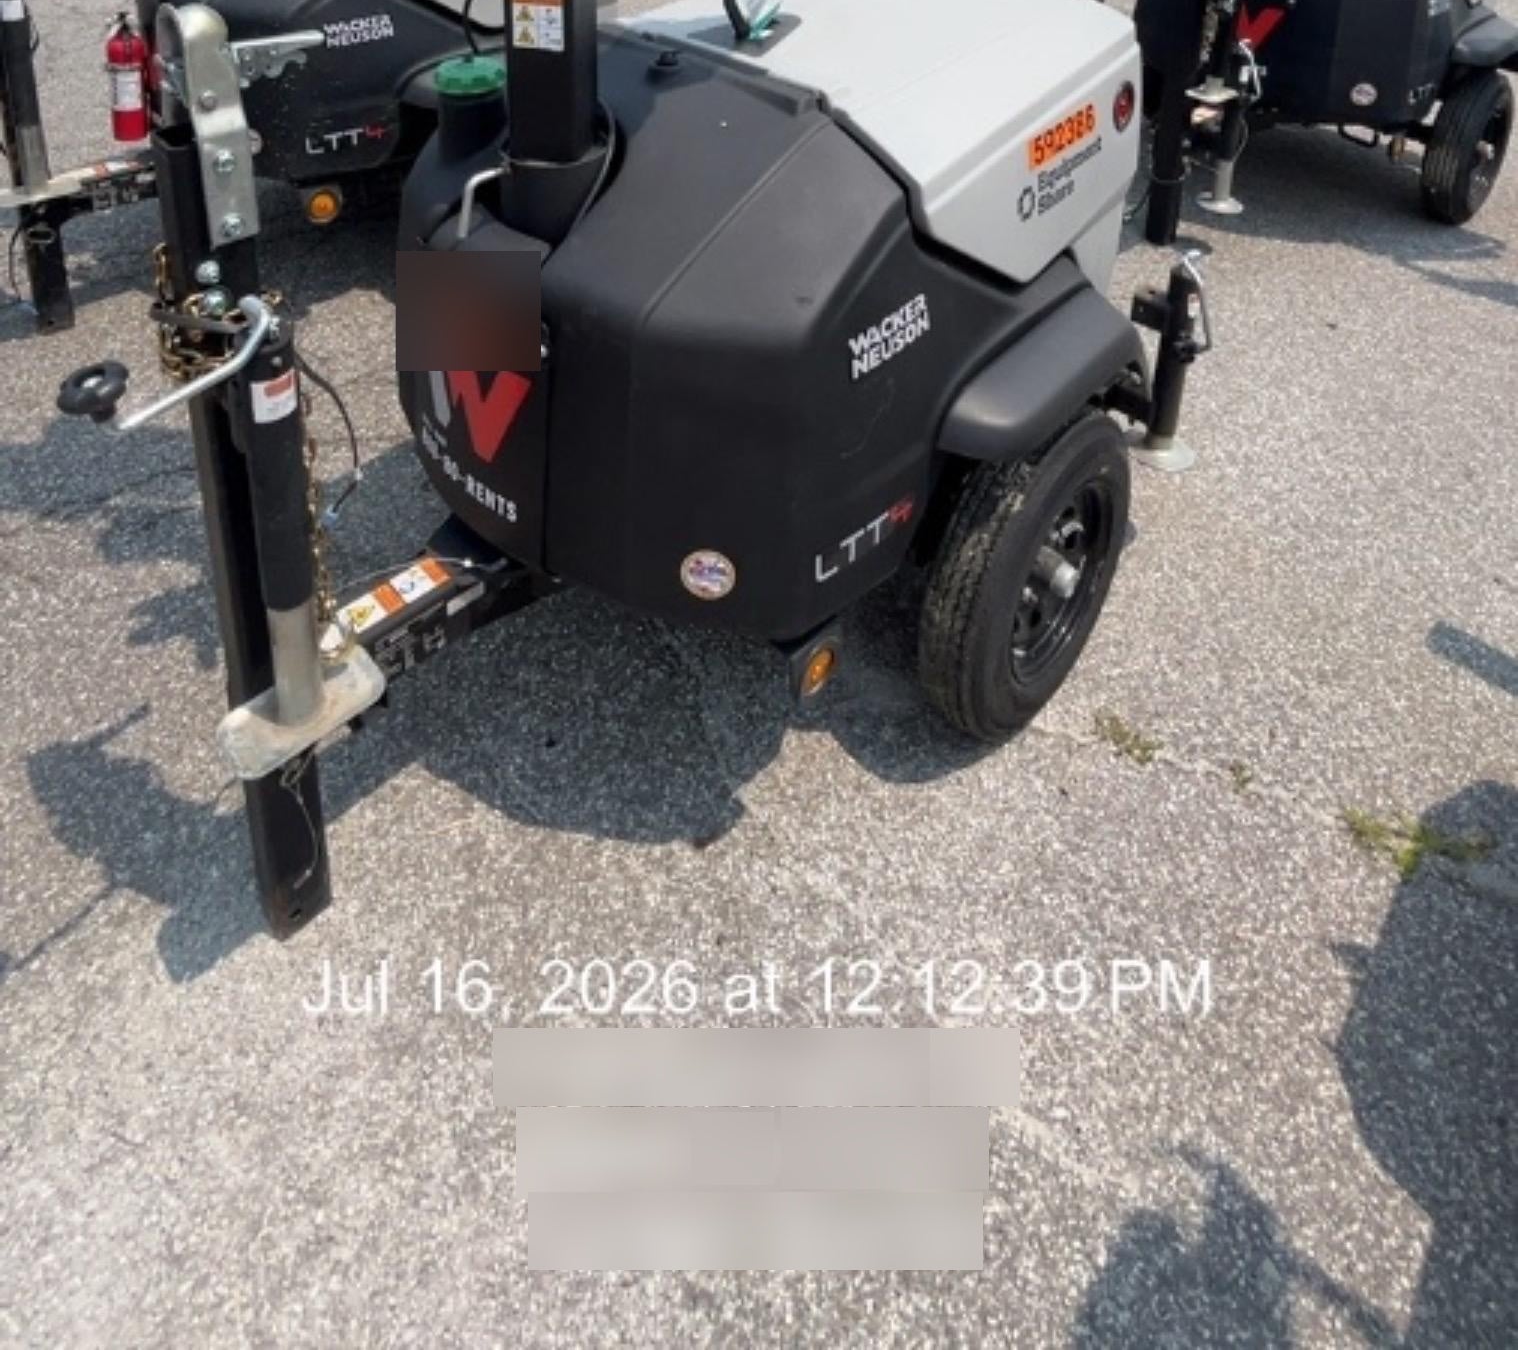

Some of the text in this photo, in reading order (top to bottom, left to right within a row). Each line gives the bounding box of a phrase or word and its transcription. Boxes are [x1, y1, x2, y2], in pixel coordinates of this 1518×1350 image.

[305, 124, 385, 155] LTT4
[1037, 179, 1075, 218] Share
[847, 292, 927, 357] WACKER
[851, 309, 930, 380] NEUSON
[814, 496, 914, 583] LTT4
